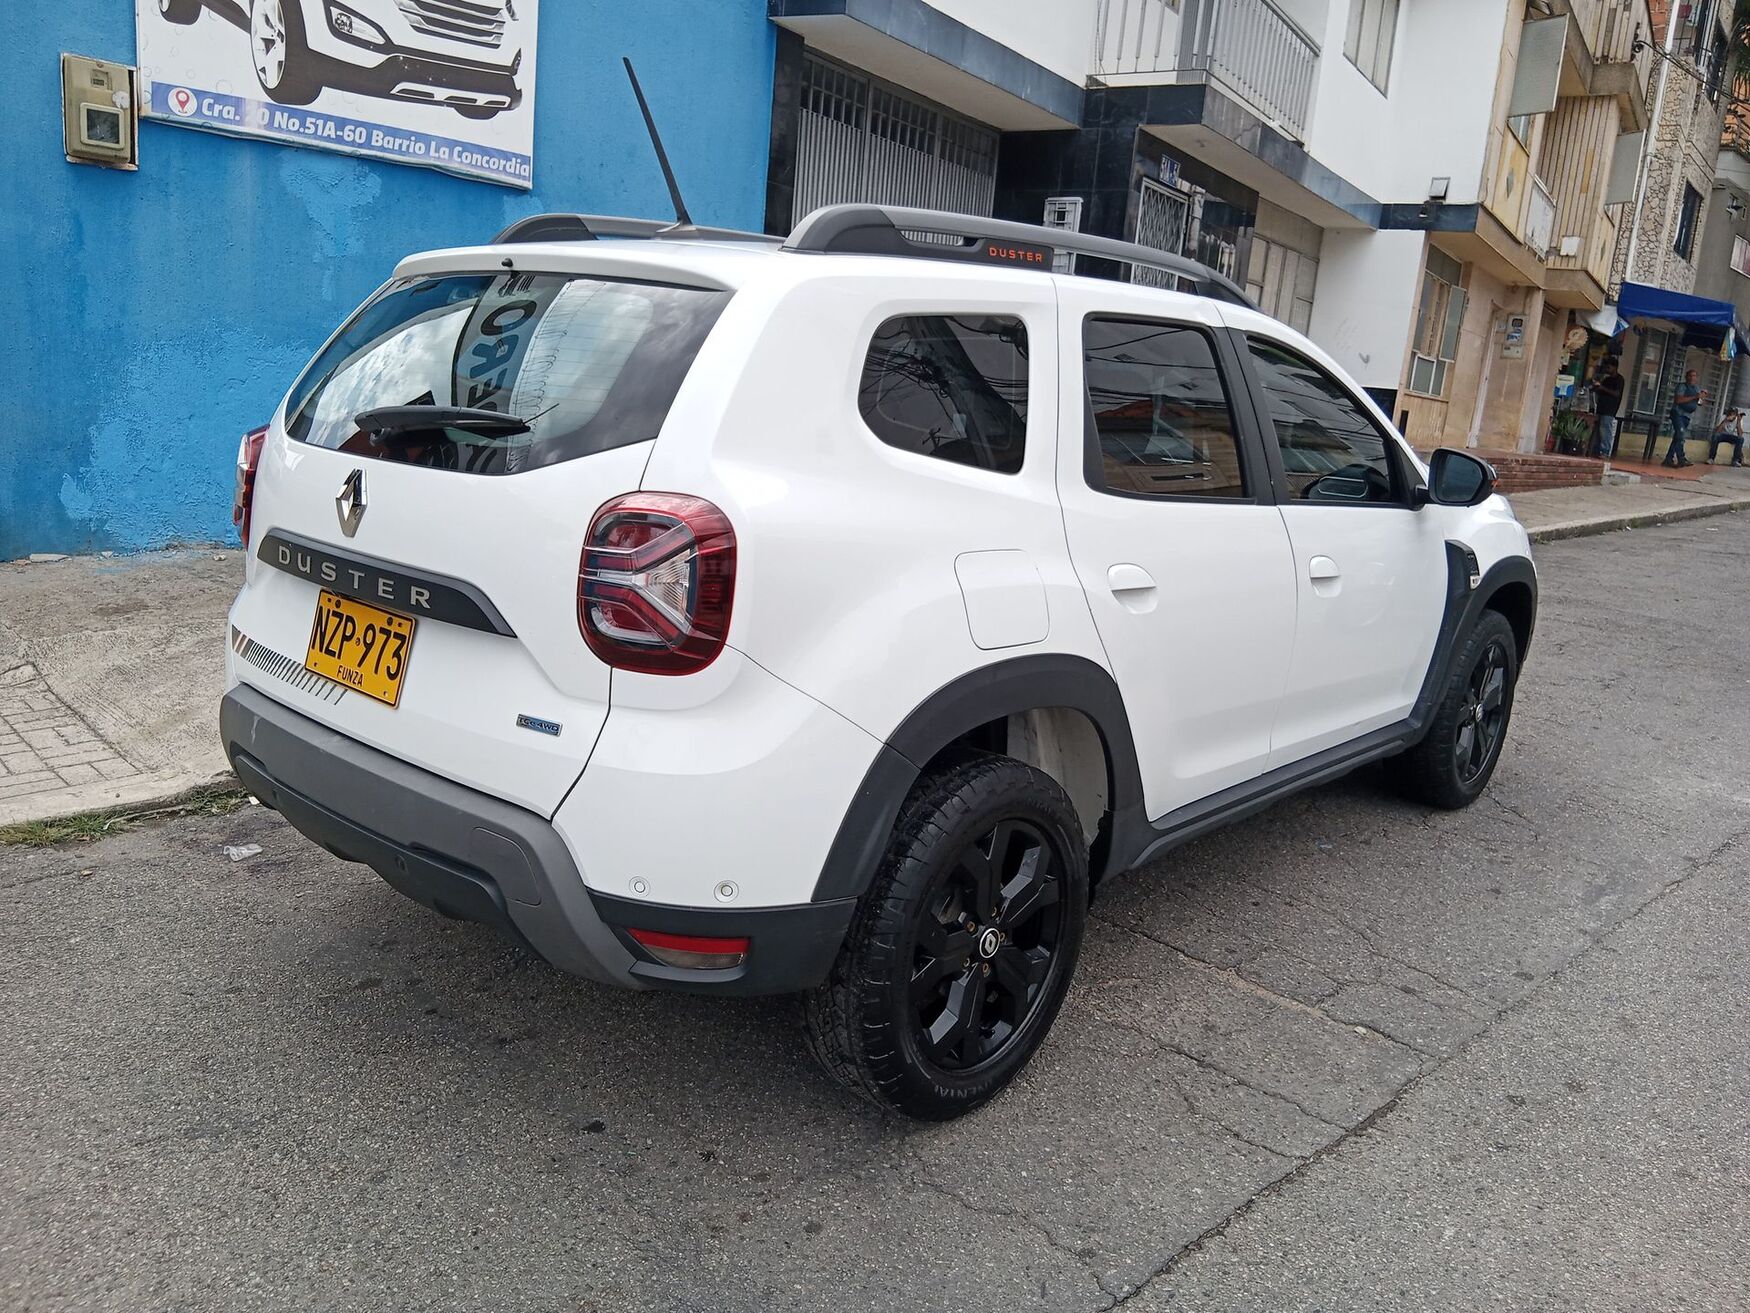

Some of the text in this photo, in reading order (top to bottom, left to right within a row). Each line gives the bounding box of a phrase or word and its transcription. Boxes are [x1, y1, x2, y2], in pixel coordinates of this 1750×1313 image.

[201, 98, 241, 122] Cra.
[273, 110, 367, 144] No.51A-60
[371, 129, 426, 155] Barrio
[429, 141, 449, 159] La
[452, 146, 530, 177] Concordia
[988, 247, 1043, 263] DUSTER
[278, 545, 432, 610] DUSTER
[336, 664, 364, 687] FUNZA
[537, 721, 559, 732] 4WD
